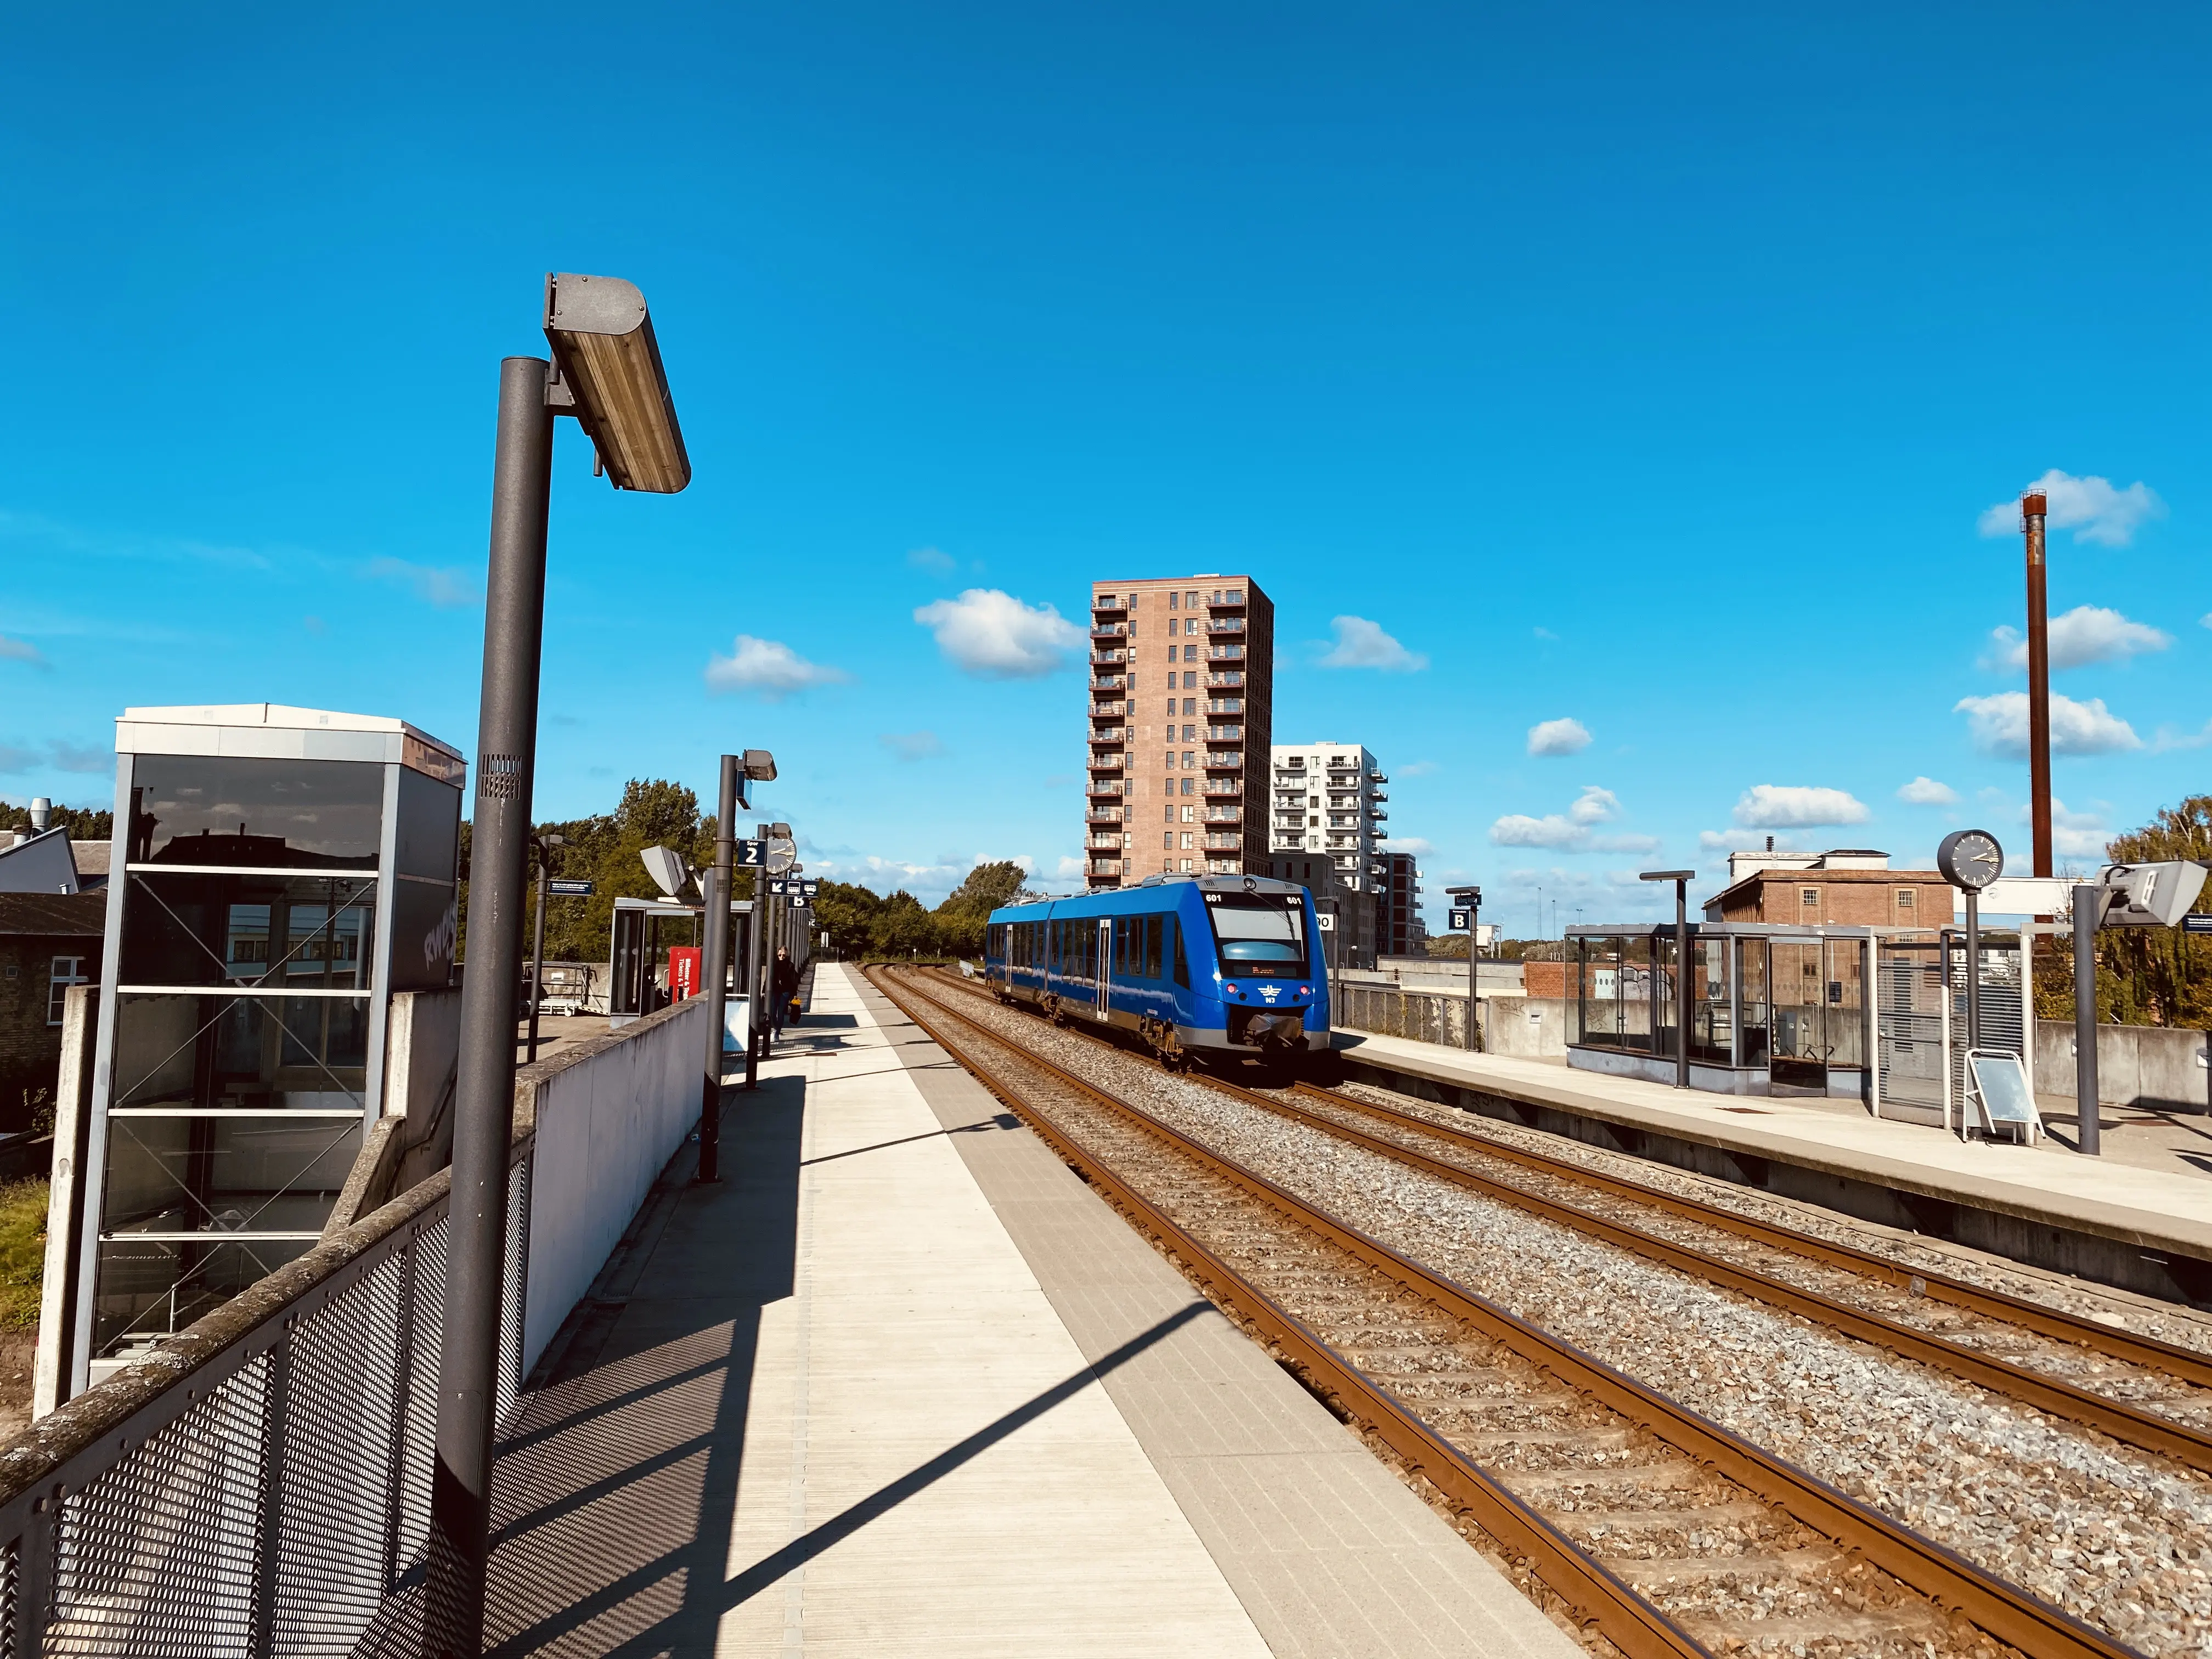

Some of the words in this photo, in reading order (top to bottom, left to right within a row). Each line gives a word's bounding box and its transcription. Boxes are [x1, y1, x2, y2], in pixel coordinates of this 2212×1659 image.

[746, 847, 757, 864] 2
[1206, 894, 1222, 902] 601
[1286, 896, 1302, 905] 601
[1455, 915, 1464, 928] B
